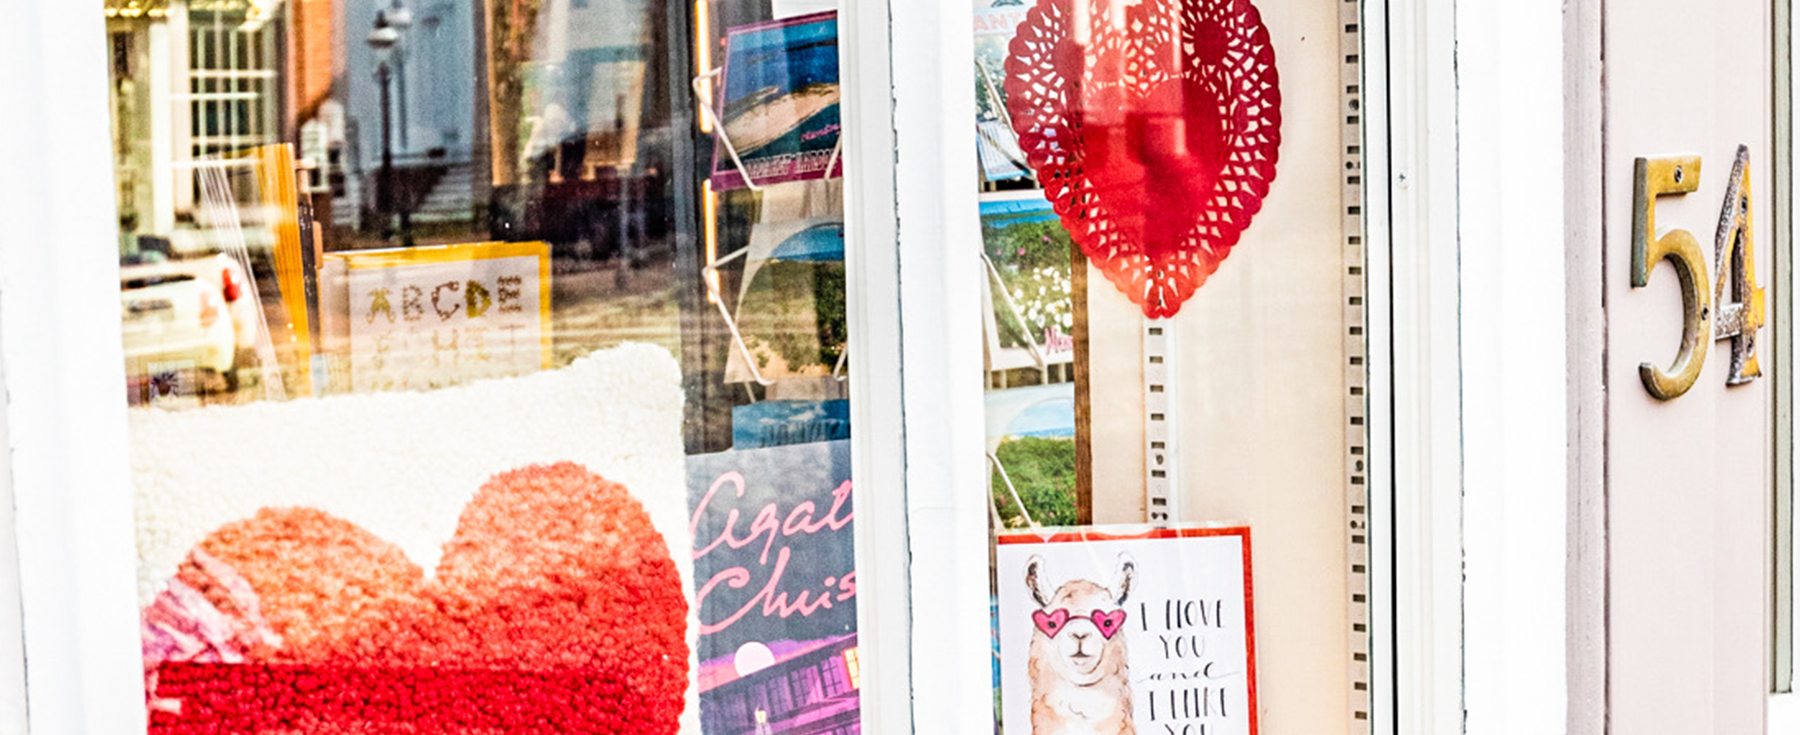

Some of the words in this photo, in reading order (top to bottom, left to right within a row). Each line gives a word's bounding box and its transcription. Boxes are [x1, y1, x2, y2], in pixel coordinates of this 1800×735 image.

[1631, 144, 1765, 400] 54
[1140, 602, 1147, 631] I
[1159, 634, 1205, 660] YOU
[1137, 661, 1240, 684] and
[1149, 690, 1155, 721] I
